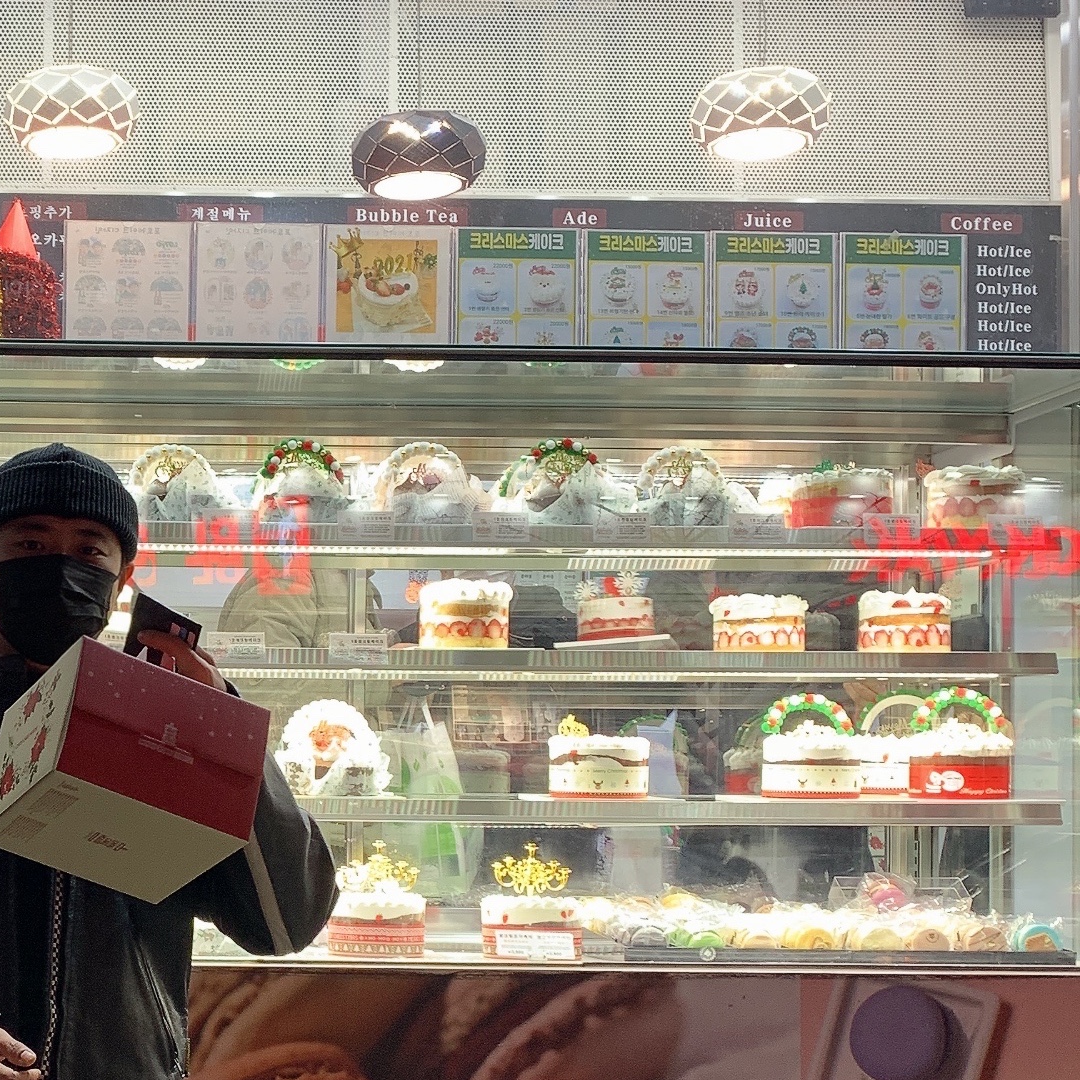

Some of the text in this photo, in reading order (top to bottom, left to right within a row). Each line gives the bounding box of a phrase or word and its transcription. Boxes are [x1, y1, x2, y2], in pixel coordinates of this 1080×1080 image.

[191, 207, 252, 221] 계절메뉴
[355, 208, 459, 223] Bubble Tea
[562, 211, 598, 225] Ade
[743, 213, 792, 228] Juice
[950, 217, 1013, 231] Coffee
[470, 232, 564, 250] 크리스마스케이크
[599, 234, 693, 253] 크리스마스케이크
[727, 236, 821, 255] 크리스마스케이크
[856, 238, 950, 256] 크리스마스케이크
[977, 245, 1032, 258] Hot/Ice
[976, 264, 1031, 277] Hot/Ice
[977, 301, 1032, 314] Hot/Ice
[977, 320, 1032, 333] Hot/Ice
[977, 339, 1032, 352] Hot/Ice
